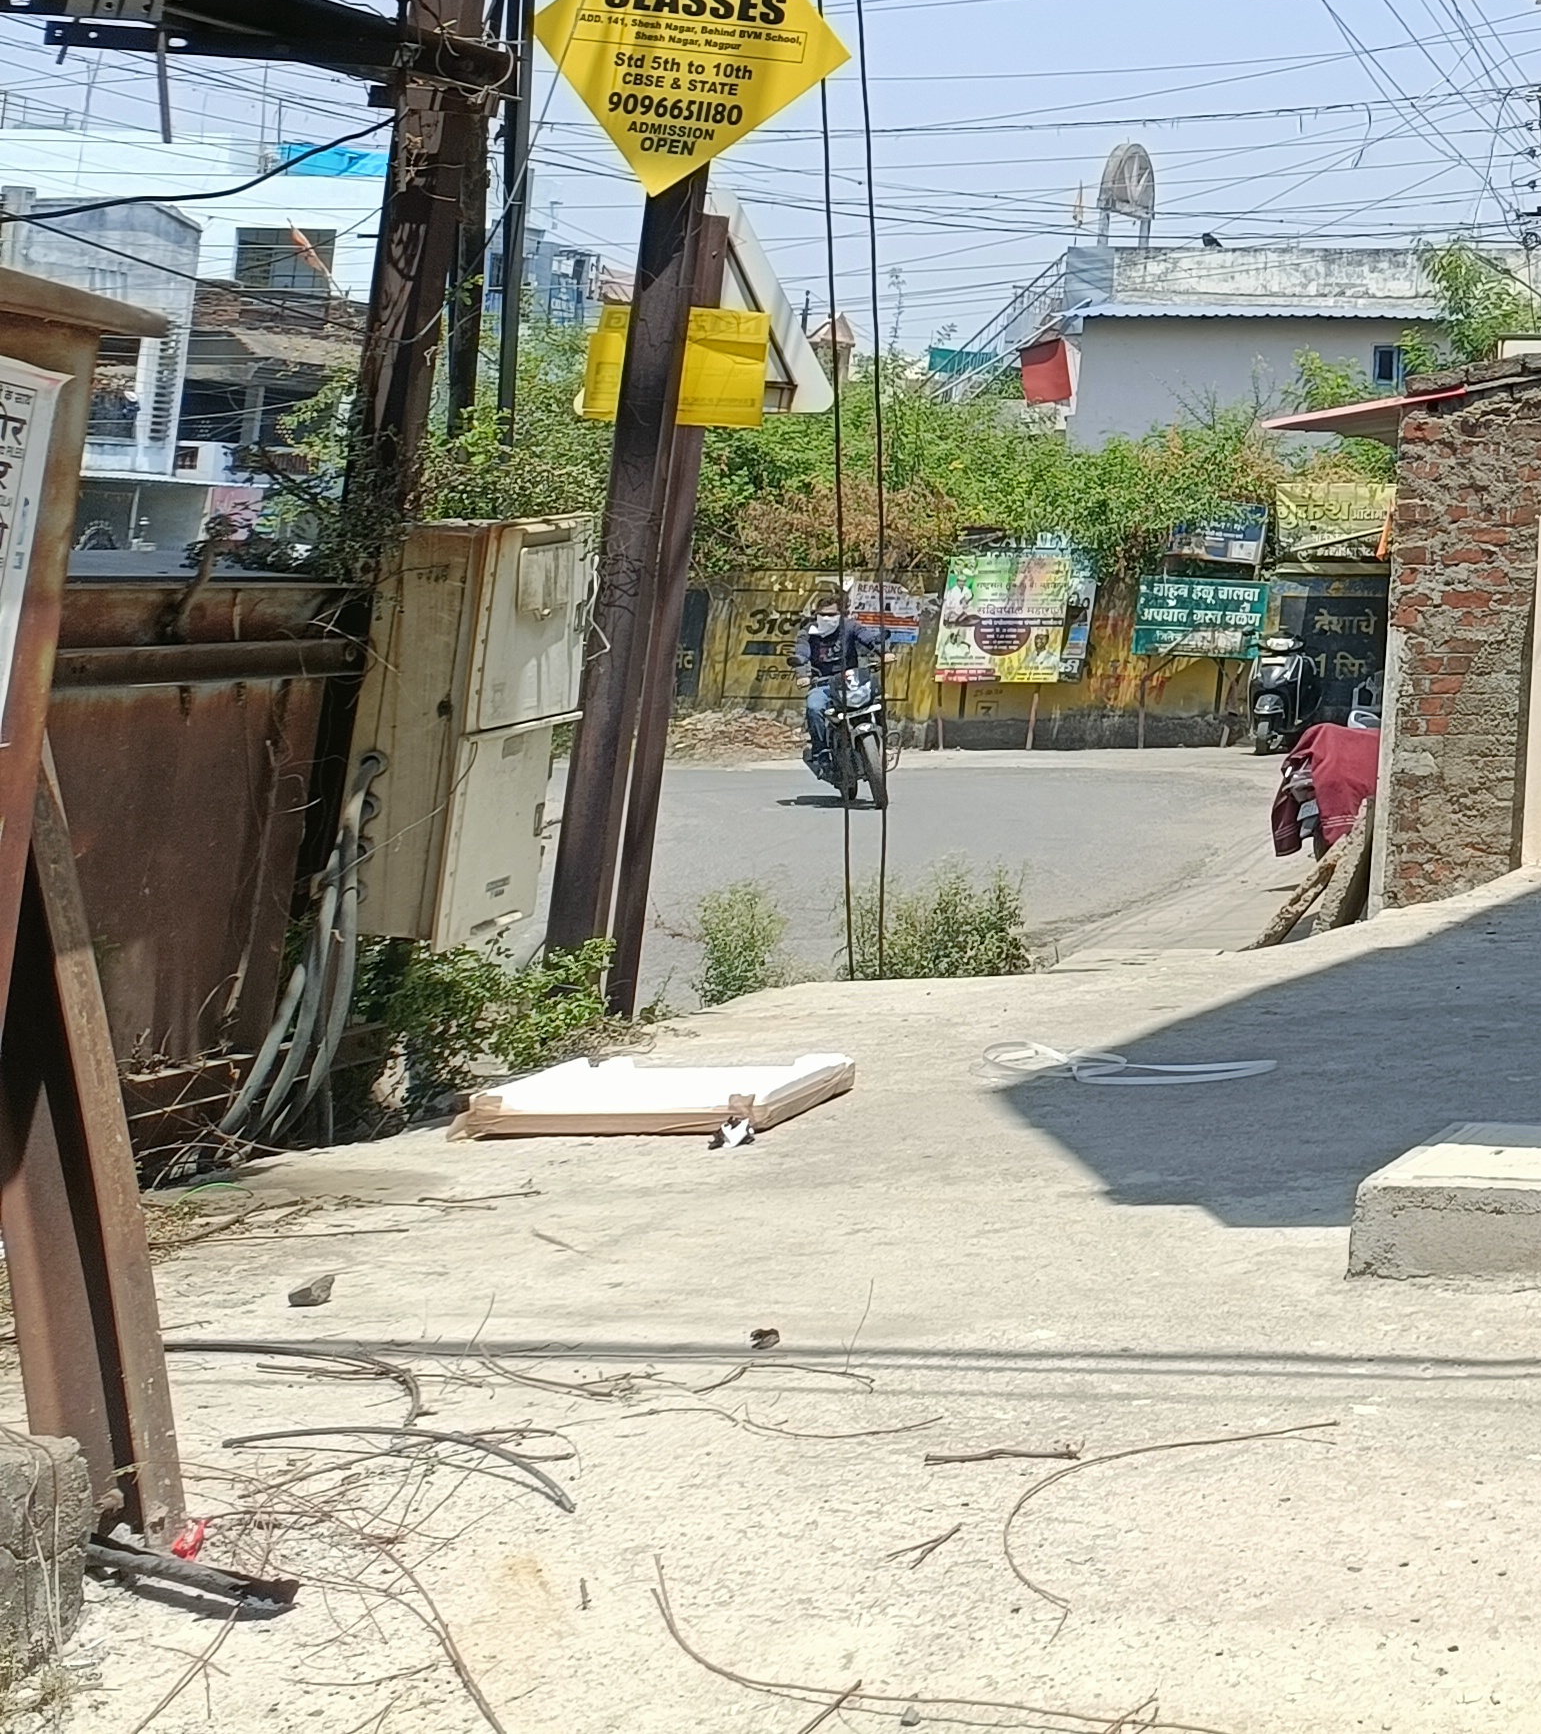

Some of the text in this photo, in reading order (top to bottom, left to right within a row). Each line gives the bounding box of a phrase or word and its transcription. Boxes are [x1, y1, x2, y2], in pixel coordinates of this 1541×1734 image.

[578, 13, 603, 24] ADD.
[607, 16, 628, 27] 141,
[631, 19, 662, 30] Shesh
[664, 22, 697, 35] Nagar,
[701, 26, 736, 38] Behind
[764, 33, 803, 46] School,
[634, 31, 742, 51] Shesh Nagar, Nagpur
[615, 52, 752, 80] Std 5th to 10th
[623, 72, 738, 96] CBSE & STATE
[609, 92, 742, 125] 9096651180
[627, 121, 715, 140] ADMISSION
[641, 137, 696, 156] OPEN
[858, 583, 904, 594] REPARING
